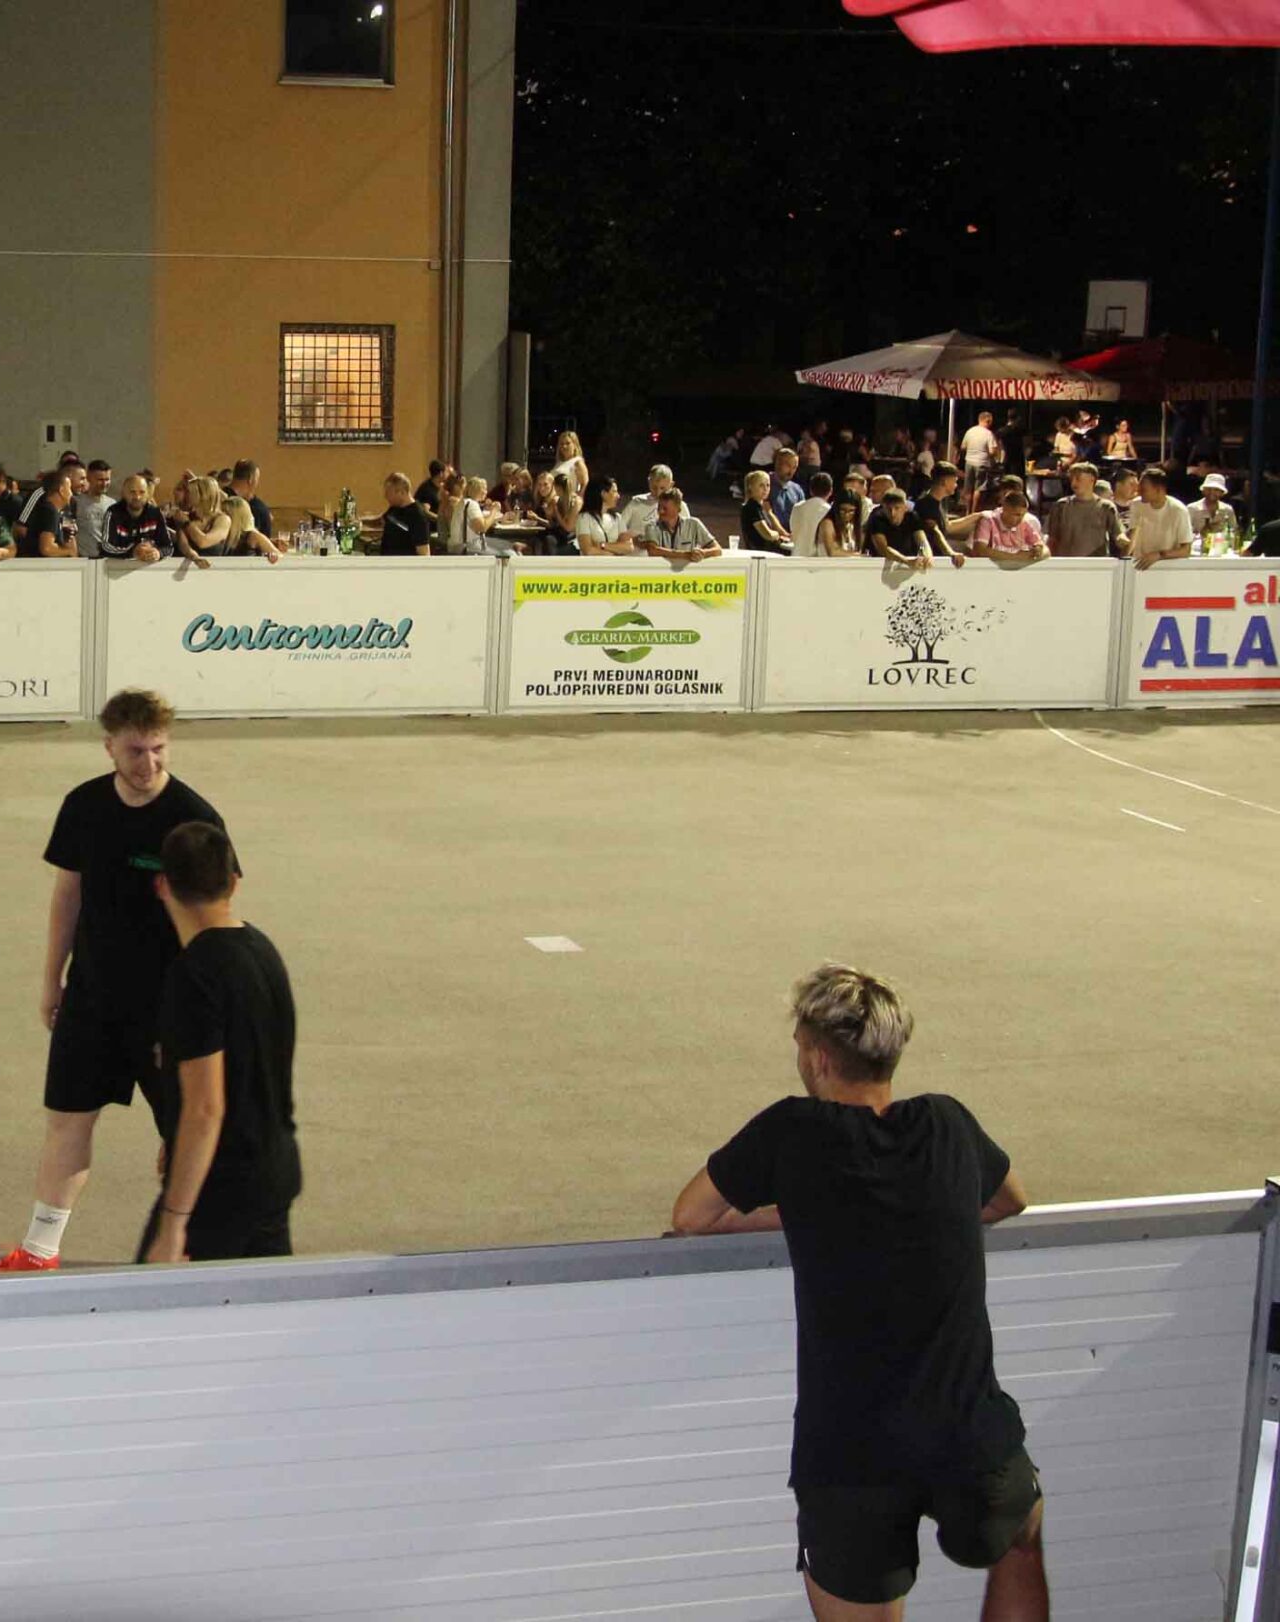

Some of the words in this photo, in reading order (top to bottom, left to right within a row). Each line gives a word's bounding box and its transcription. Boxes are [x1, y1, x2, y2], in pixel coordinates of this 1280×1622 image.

[521, 579, 738, 597] www.agraria-market.com
[1243, 575, 1280, 606] al
[181, 612, 414, 654] Centrometal
[571, 631, 696, 645] AGRARIA-MARKET
[286, 652, 343, 661] TEHNIKA
[553, 669, 589, 682] PRVI
[593, 669, 699, 682] MEĐUNARODNI
[868, 666, 977, 689] LOVREC
[525, 683, 650, 697] POLJOPRIVREDNI
[654, 682, 724, 695] OGLASNIK
